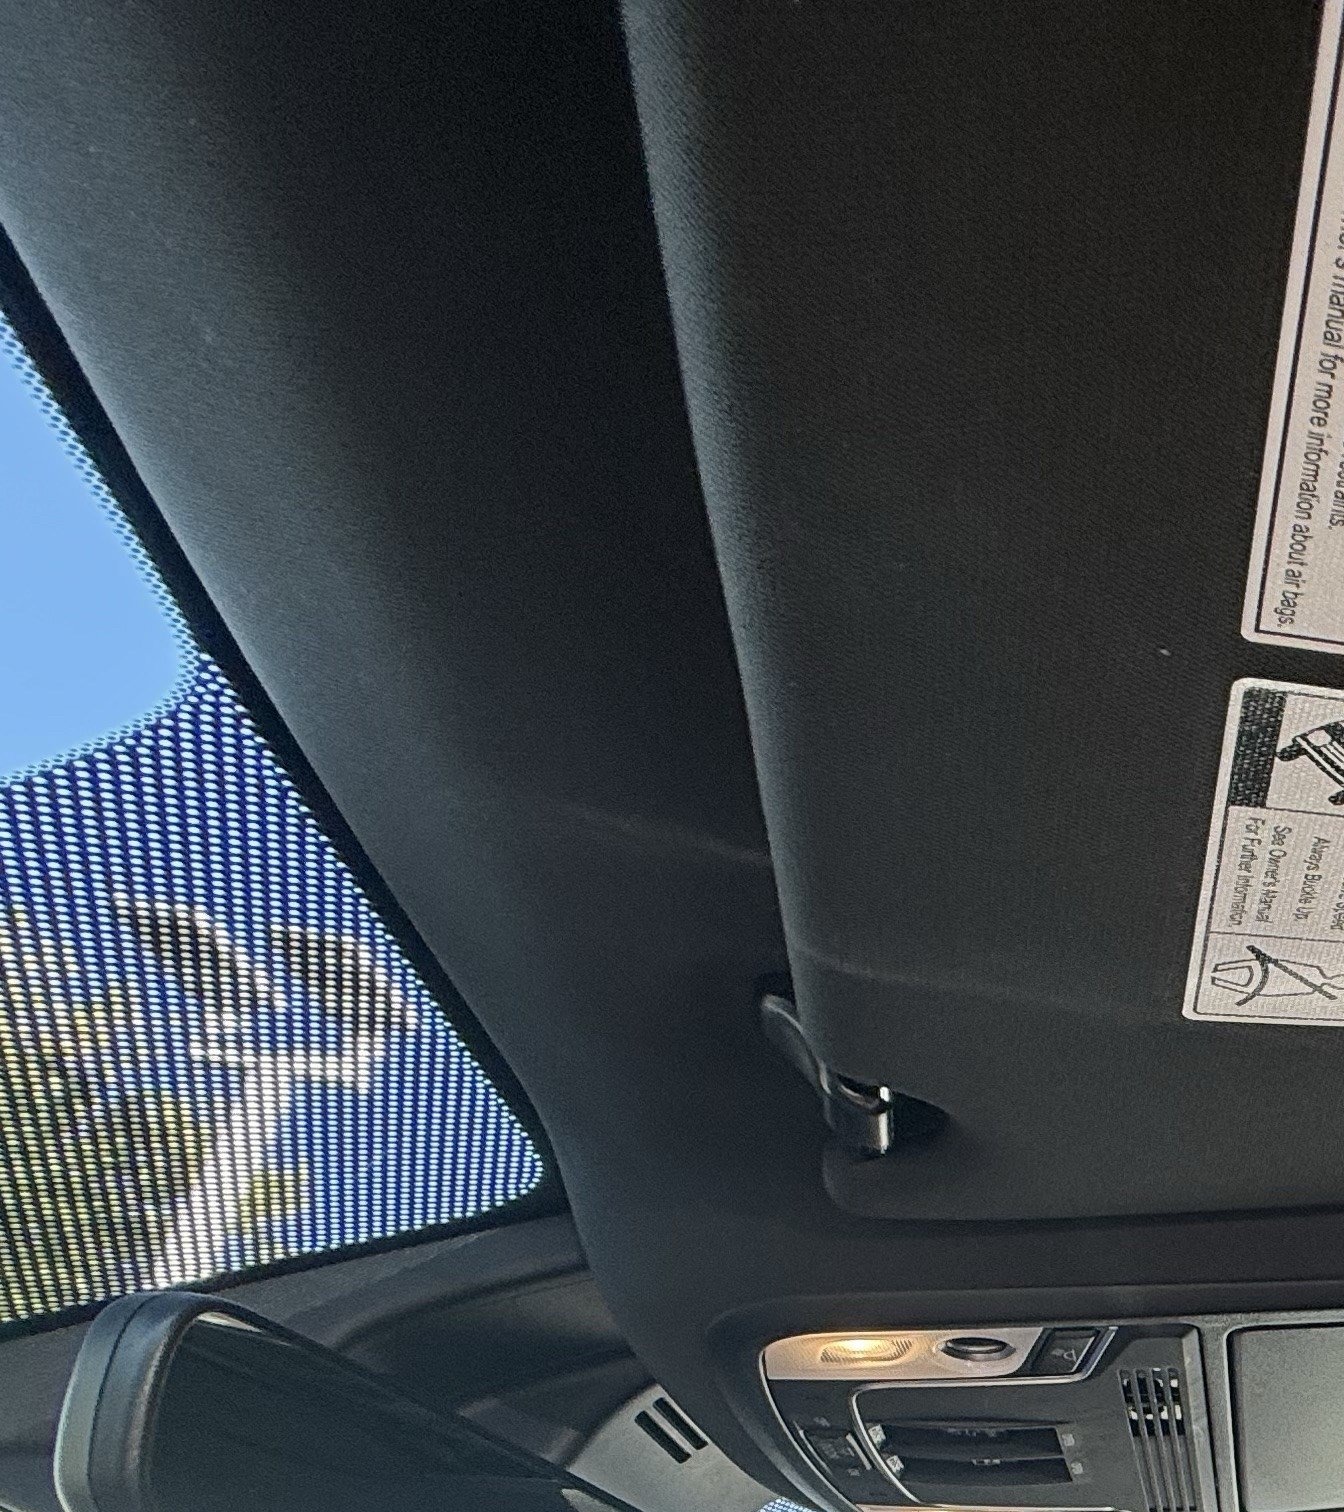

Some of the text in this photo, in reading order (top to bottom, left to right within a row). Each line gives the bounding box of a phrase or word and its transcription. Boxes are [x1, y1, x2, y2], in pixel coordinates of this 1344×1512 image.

[1318, 352, 1344, 379] for
[1309, 382, 1332, 426] more
[1295, 430, 1331, 519] information
[1287, 523, 1312, 566] about
[1284, 569, 1305, 588] air
[1274, 590, 1303, 626] bags.
[1244, 816, 1266, 835] For
[1238, 836, 1262, 873] Further
[1302, 836, 1331, 871] Always
[1255, 825, 1292, 923] See Owner's Manual
[1298, 873, 1323, 904] Buckle
